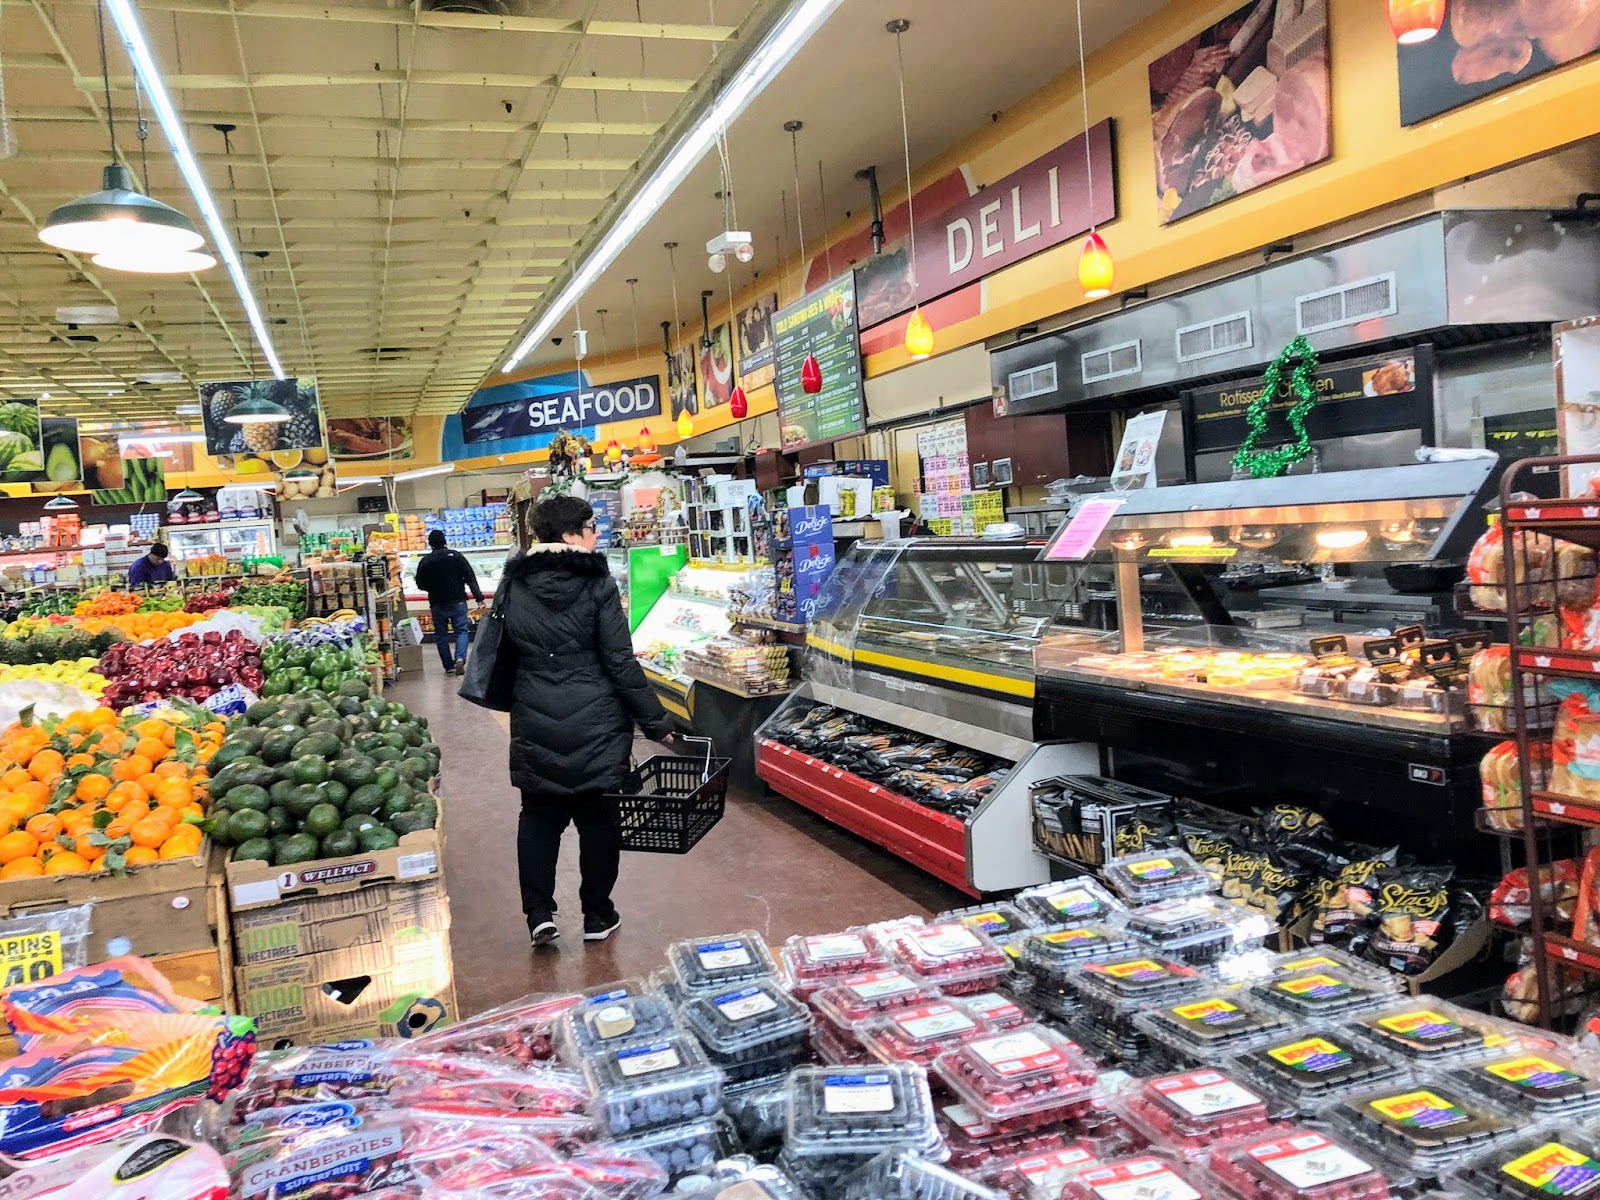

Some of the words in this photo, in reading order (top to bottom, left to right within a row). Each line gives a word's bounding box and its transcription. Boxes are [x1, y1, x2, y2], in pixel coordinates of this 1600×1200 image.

[946, 166, 1063, 275] DELI
[528, 383, 655, 427] SEAFOOD
[284, 873, 293, 887] 1
[247, 944, 299, 962] HECTARES
[258, 1005, 302, 1022] ECTARES
[250, 1136, 393, 1186] CRANBERRIES
[285, 1162, 362, 1191] SUPERFRUIT
